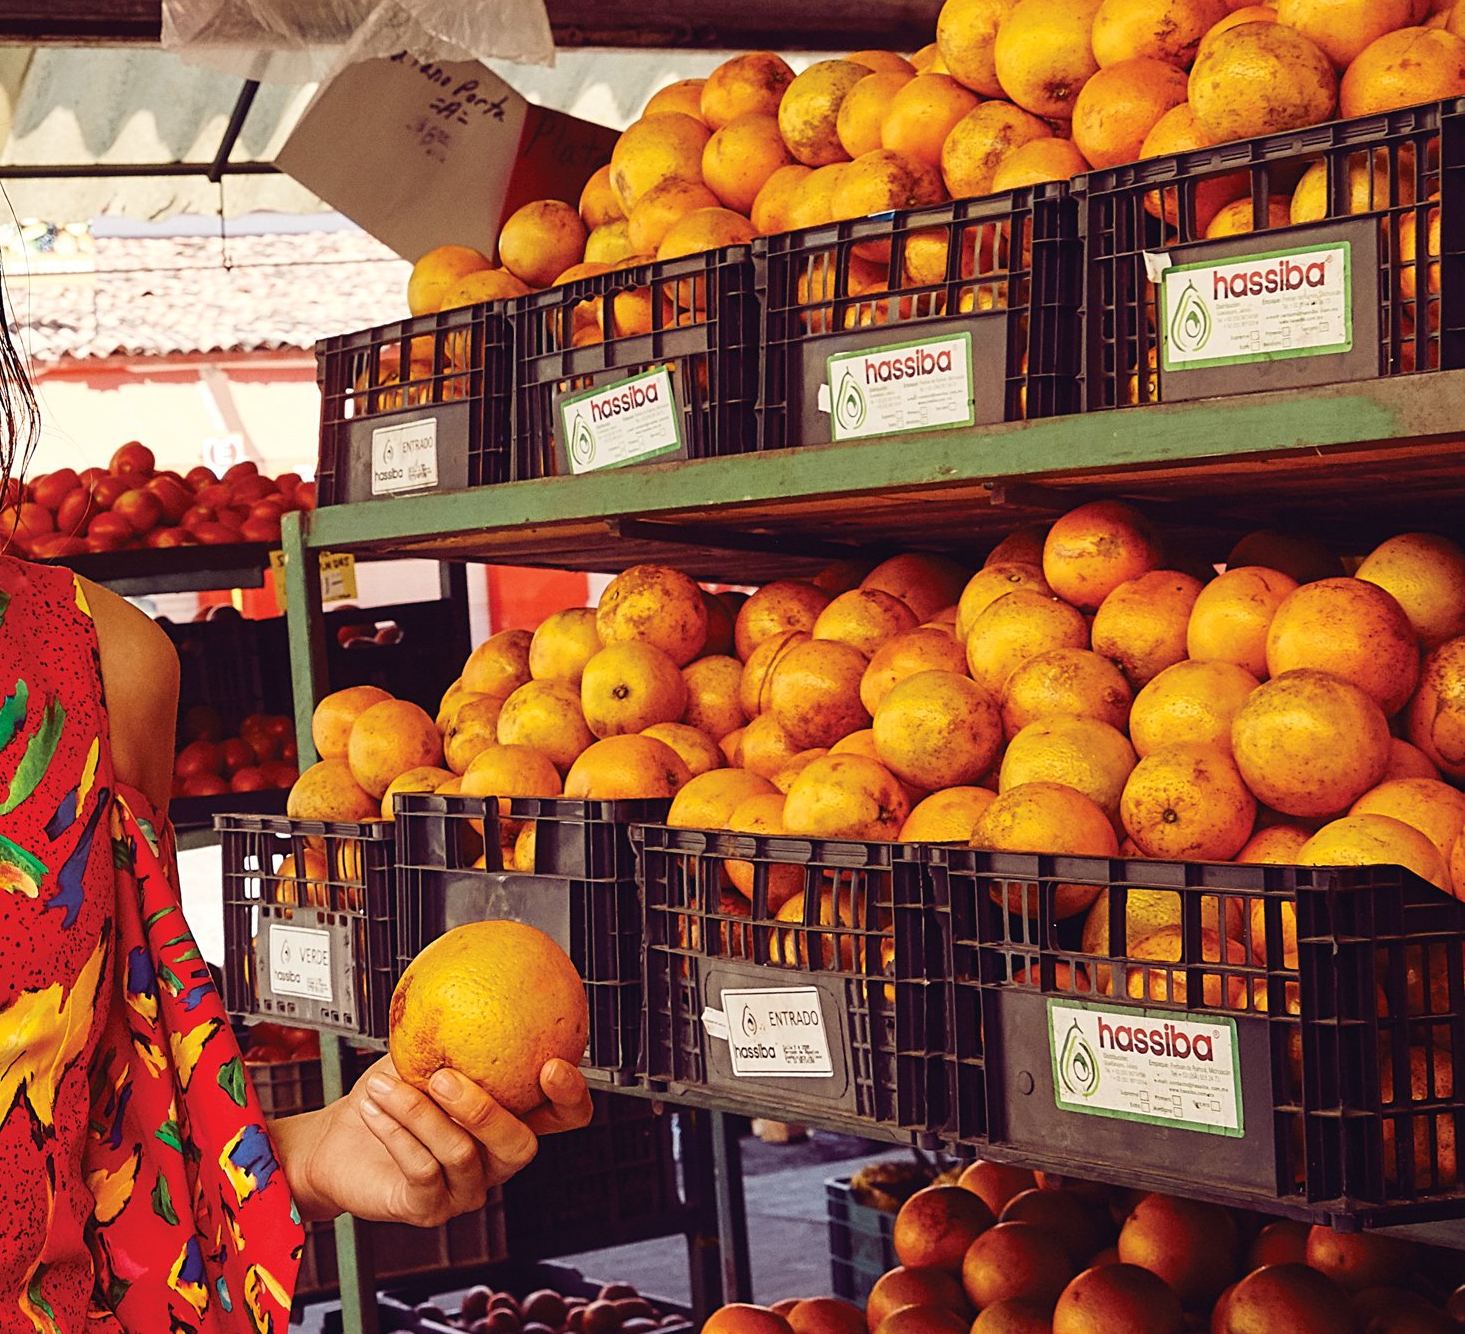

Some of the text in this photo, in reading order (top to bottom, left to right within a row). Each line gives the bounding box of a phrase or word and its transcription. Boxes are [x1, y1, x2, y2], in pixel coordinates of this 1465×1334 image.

[1212, 260, 1325, 300] hassiba
[864, 348, 952, 385] hassiba
[590, 383, 659, 423] hassiba
[768, 1010, 820, 1027] ENTRADO
[1097, 1016, 1214, 1062] hassiba
